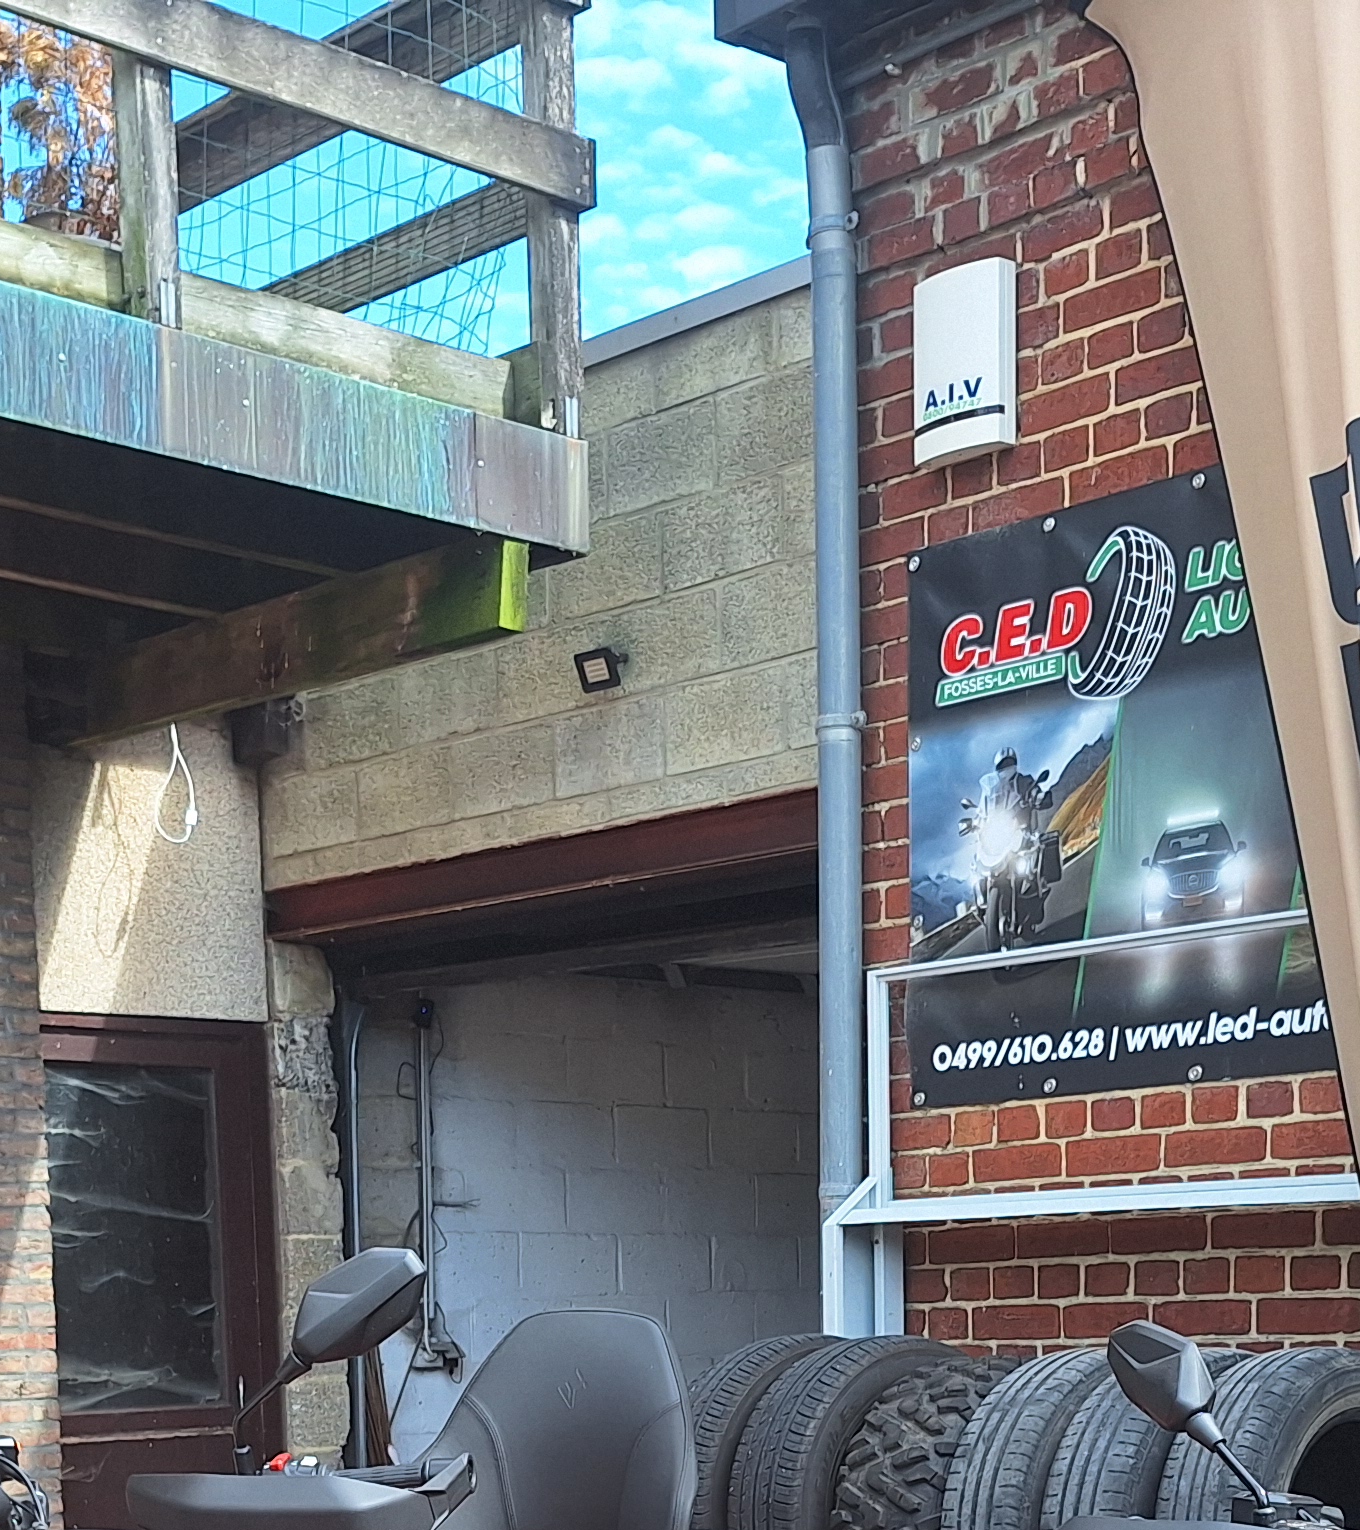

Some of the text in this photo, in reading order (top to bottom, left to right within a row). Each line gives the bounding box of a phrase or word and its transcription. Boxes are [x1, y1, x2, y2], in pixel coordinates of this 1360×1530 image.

[924, 376, 983, 412] A.I.V
[940, 586, 1093, 677] C.E.D
[943, 658, 1057, 700] FOSSES-LA-VILLE
[932, 1017, 1105, 1072] 0499/610.628
[1124, 998, 1331, 1054] www.led-aut
